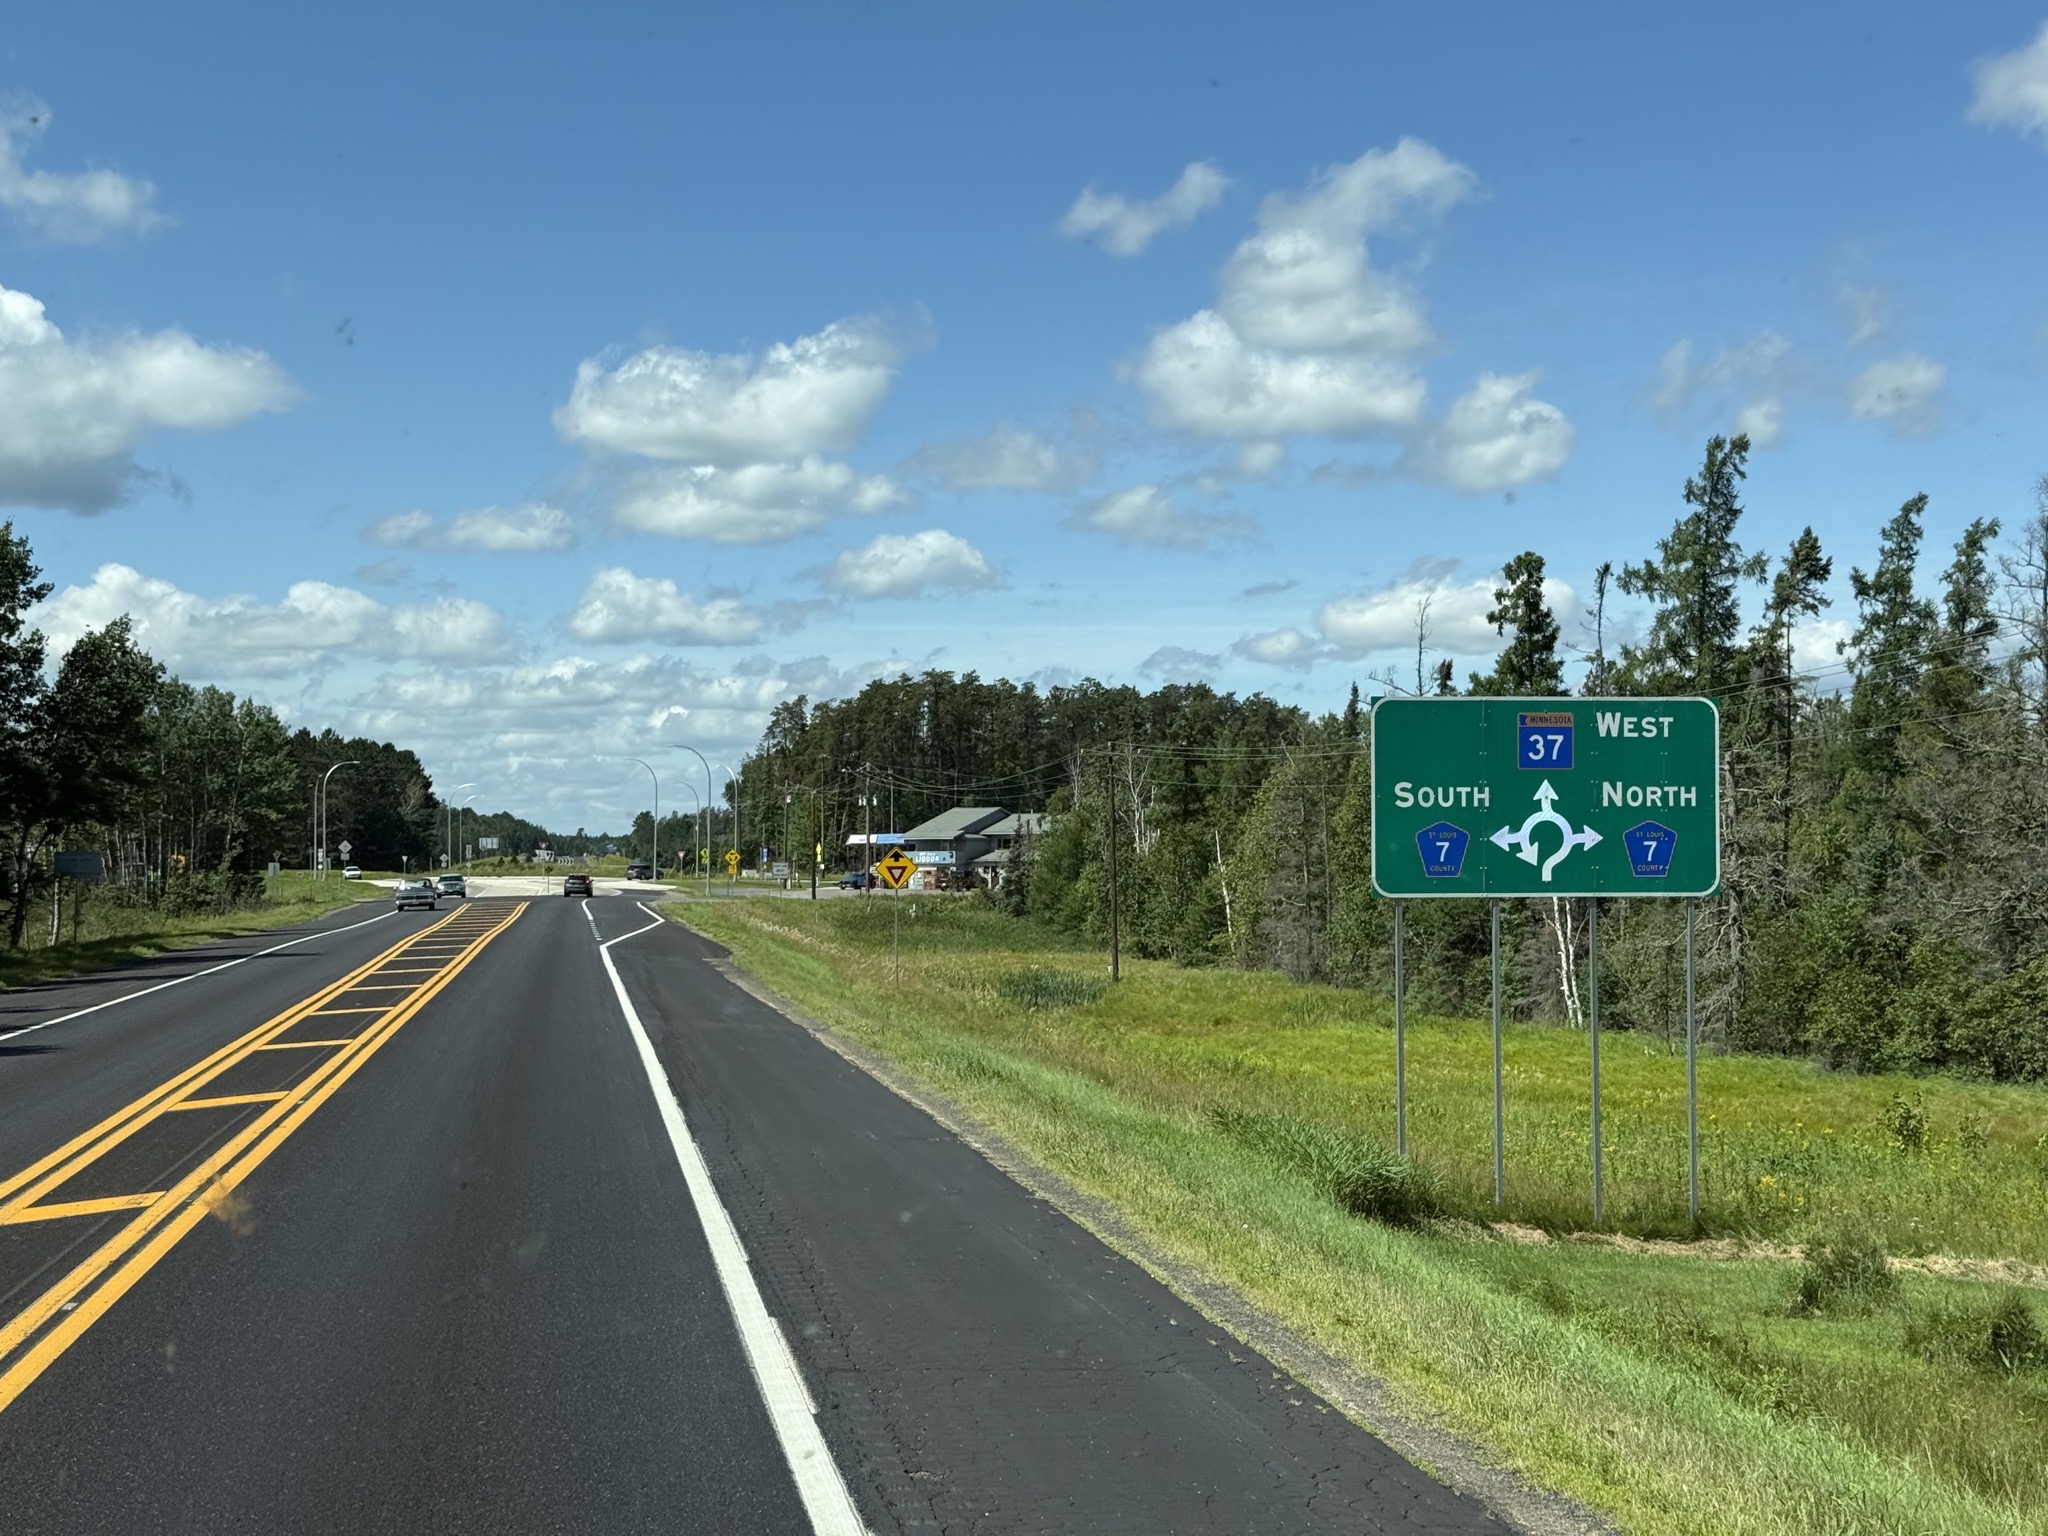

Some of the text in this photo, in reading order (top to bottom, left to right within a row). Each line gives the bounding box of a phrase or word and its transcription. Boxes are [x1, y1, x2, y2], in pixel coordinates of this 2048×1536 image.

[1530, 716, 1572, 724] MINNESOTA
[1596, 712, 1674, 738] WEST
[1528, 734, 1564, 760] 37
[1394, 781, 1490, 808] SOUTH
[1602, 781, 1697, 807] NORTH
[1436, 841, 1450, 862] 7
[1643, 841, 1657, 862] 7
[1637, 864, 1662, 872] COUNTY
